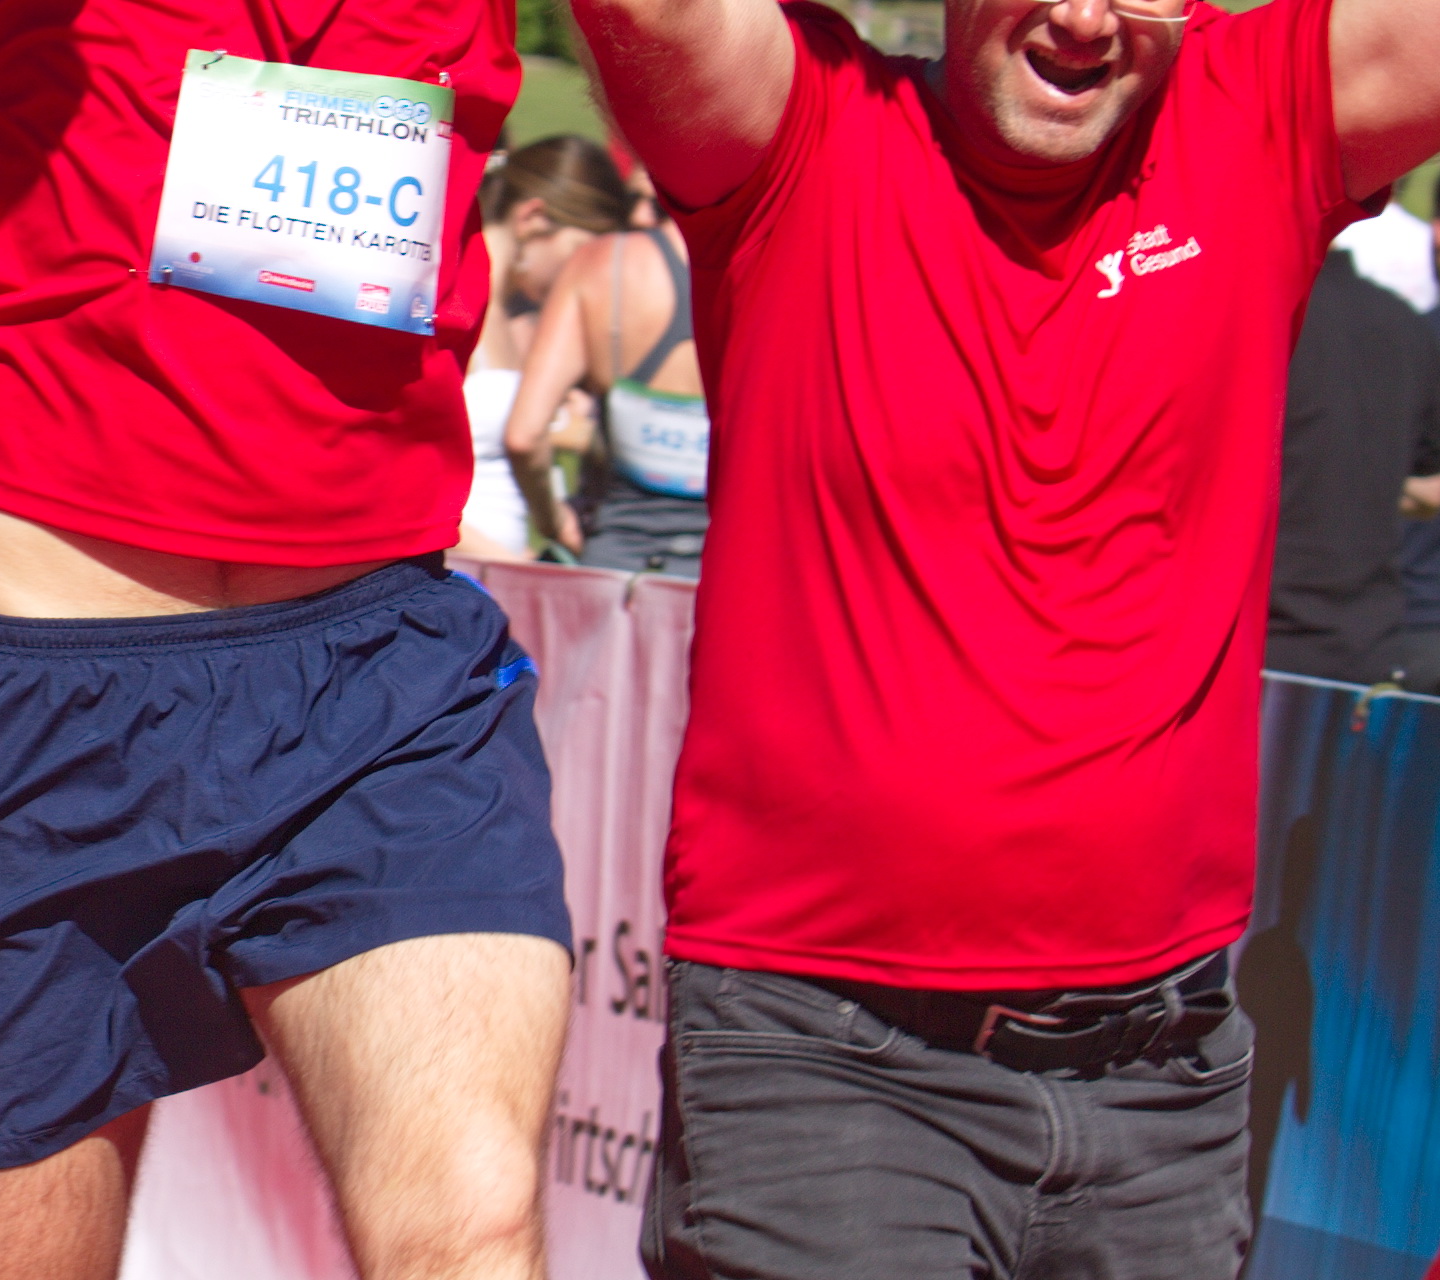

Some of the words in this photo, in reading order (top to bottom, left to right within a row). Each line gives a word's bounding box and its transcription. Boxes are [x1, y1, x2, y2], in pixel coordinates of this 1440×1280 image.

[285, 91, 372, 115] FIRMEN
[280, 105, 428, 144] TRIATHLON
[253, 154, 424, 227] 418-C
[192, 201, 230, 224] DIE
[237, 209, 344, 244] FLOTTEN
[1126, 224, 1172, 255] Stadt
[1130, 236, 1202, 276] Gesund
